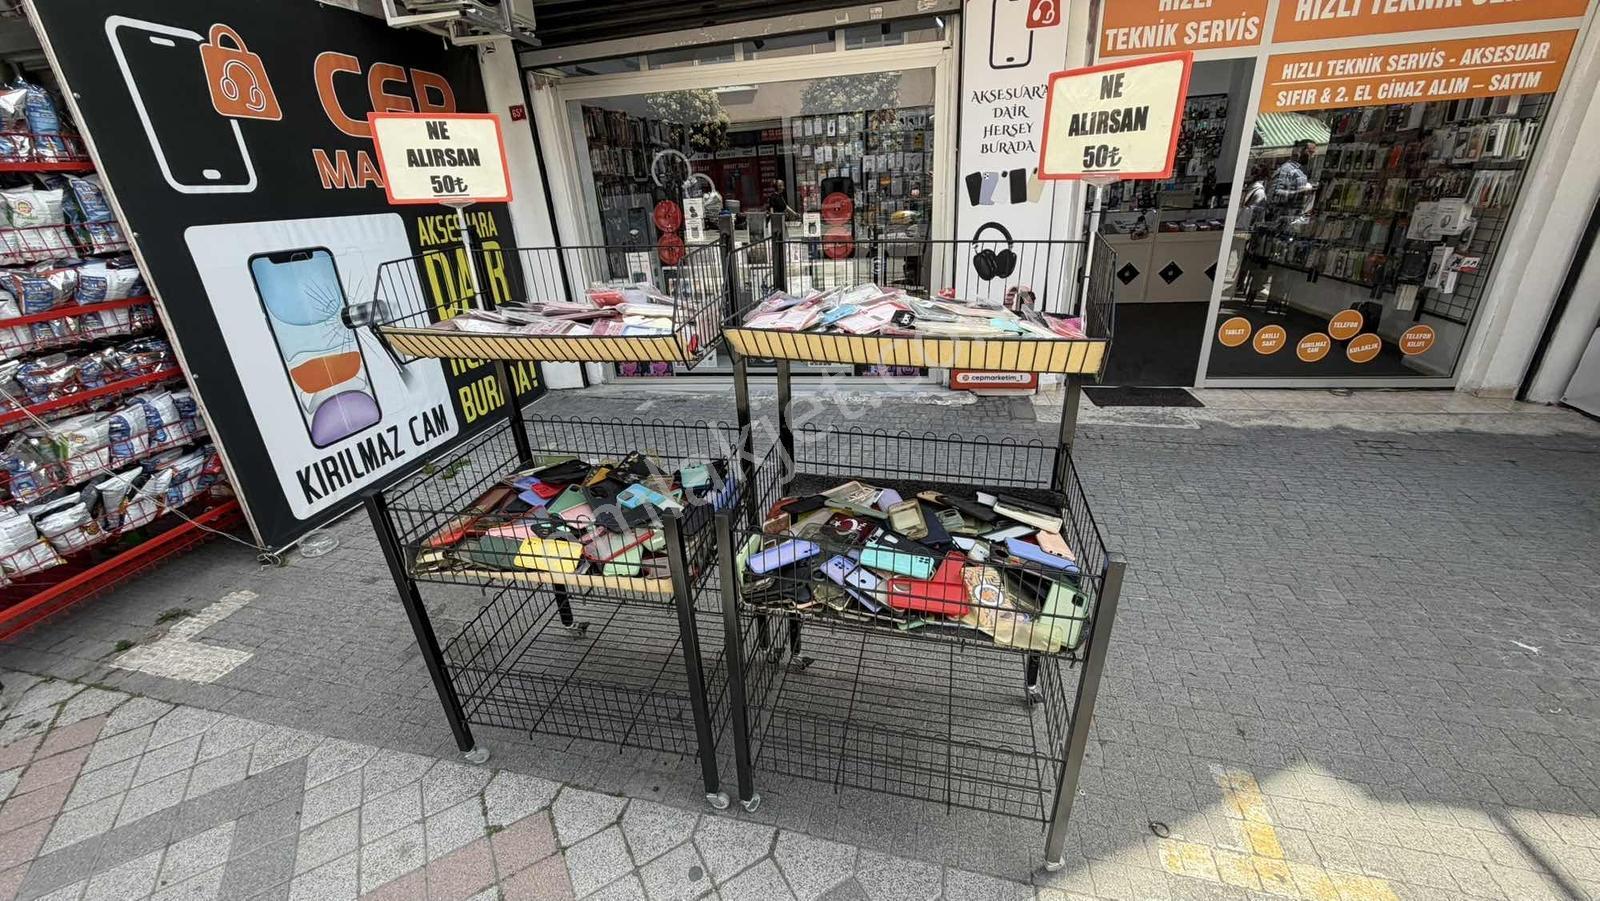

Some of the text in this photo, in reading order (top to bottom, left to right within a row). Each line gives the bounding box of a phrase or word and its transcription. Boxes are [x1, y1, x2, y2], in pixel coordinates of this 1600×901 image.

[1105, 12, 1260, 51] TEKNİK SERVİS
[1281, 61, 1323, 80] HIZLI
[1327, 53, 1384, 76] TEKNİK
[1387, 48, 1446, 71] SERVİS
[1460, 42, 1551, 66] AKSESUAR
[314, 51, 457, 138] CEP
[1100, 73, 1126, 100] NE
[1276, 88, 1317, 106] SIFIR
[1320, 87, 1331, 104] &
[1335, 86, 1349, 103] 2.
[1354, 85, 1373, 101] EL
[1377, 79, 1426, 100] CİHAZ
[1427, 77, 1470, 96] ALIM
[1488, 71, 1543, 92] SATIM
[992, 103, 1030, 119] DAİR
[425, 120, 451, 140] NE
[982, 122, 1034, 139] HERSEY
[406, 148, 481, 168] ALIRSAN
[980, 140, 1036, 154] BURADA
[423, 240, 512, 320] DAR
[1333, 321, 1359, 329] TELEFON
[1349, 342, 1379, 354] KULAKLIK
[296, 403, 450, 504] KIRILMAZ CAM
